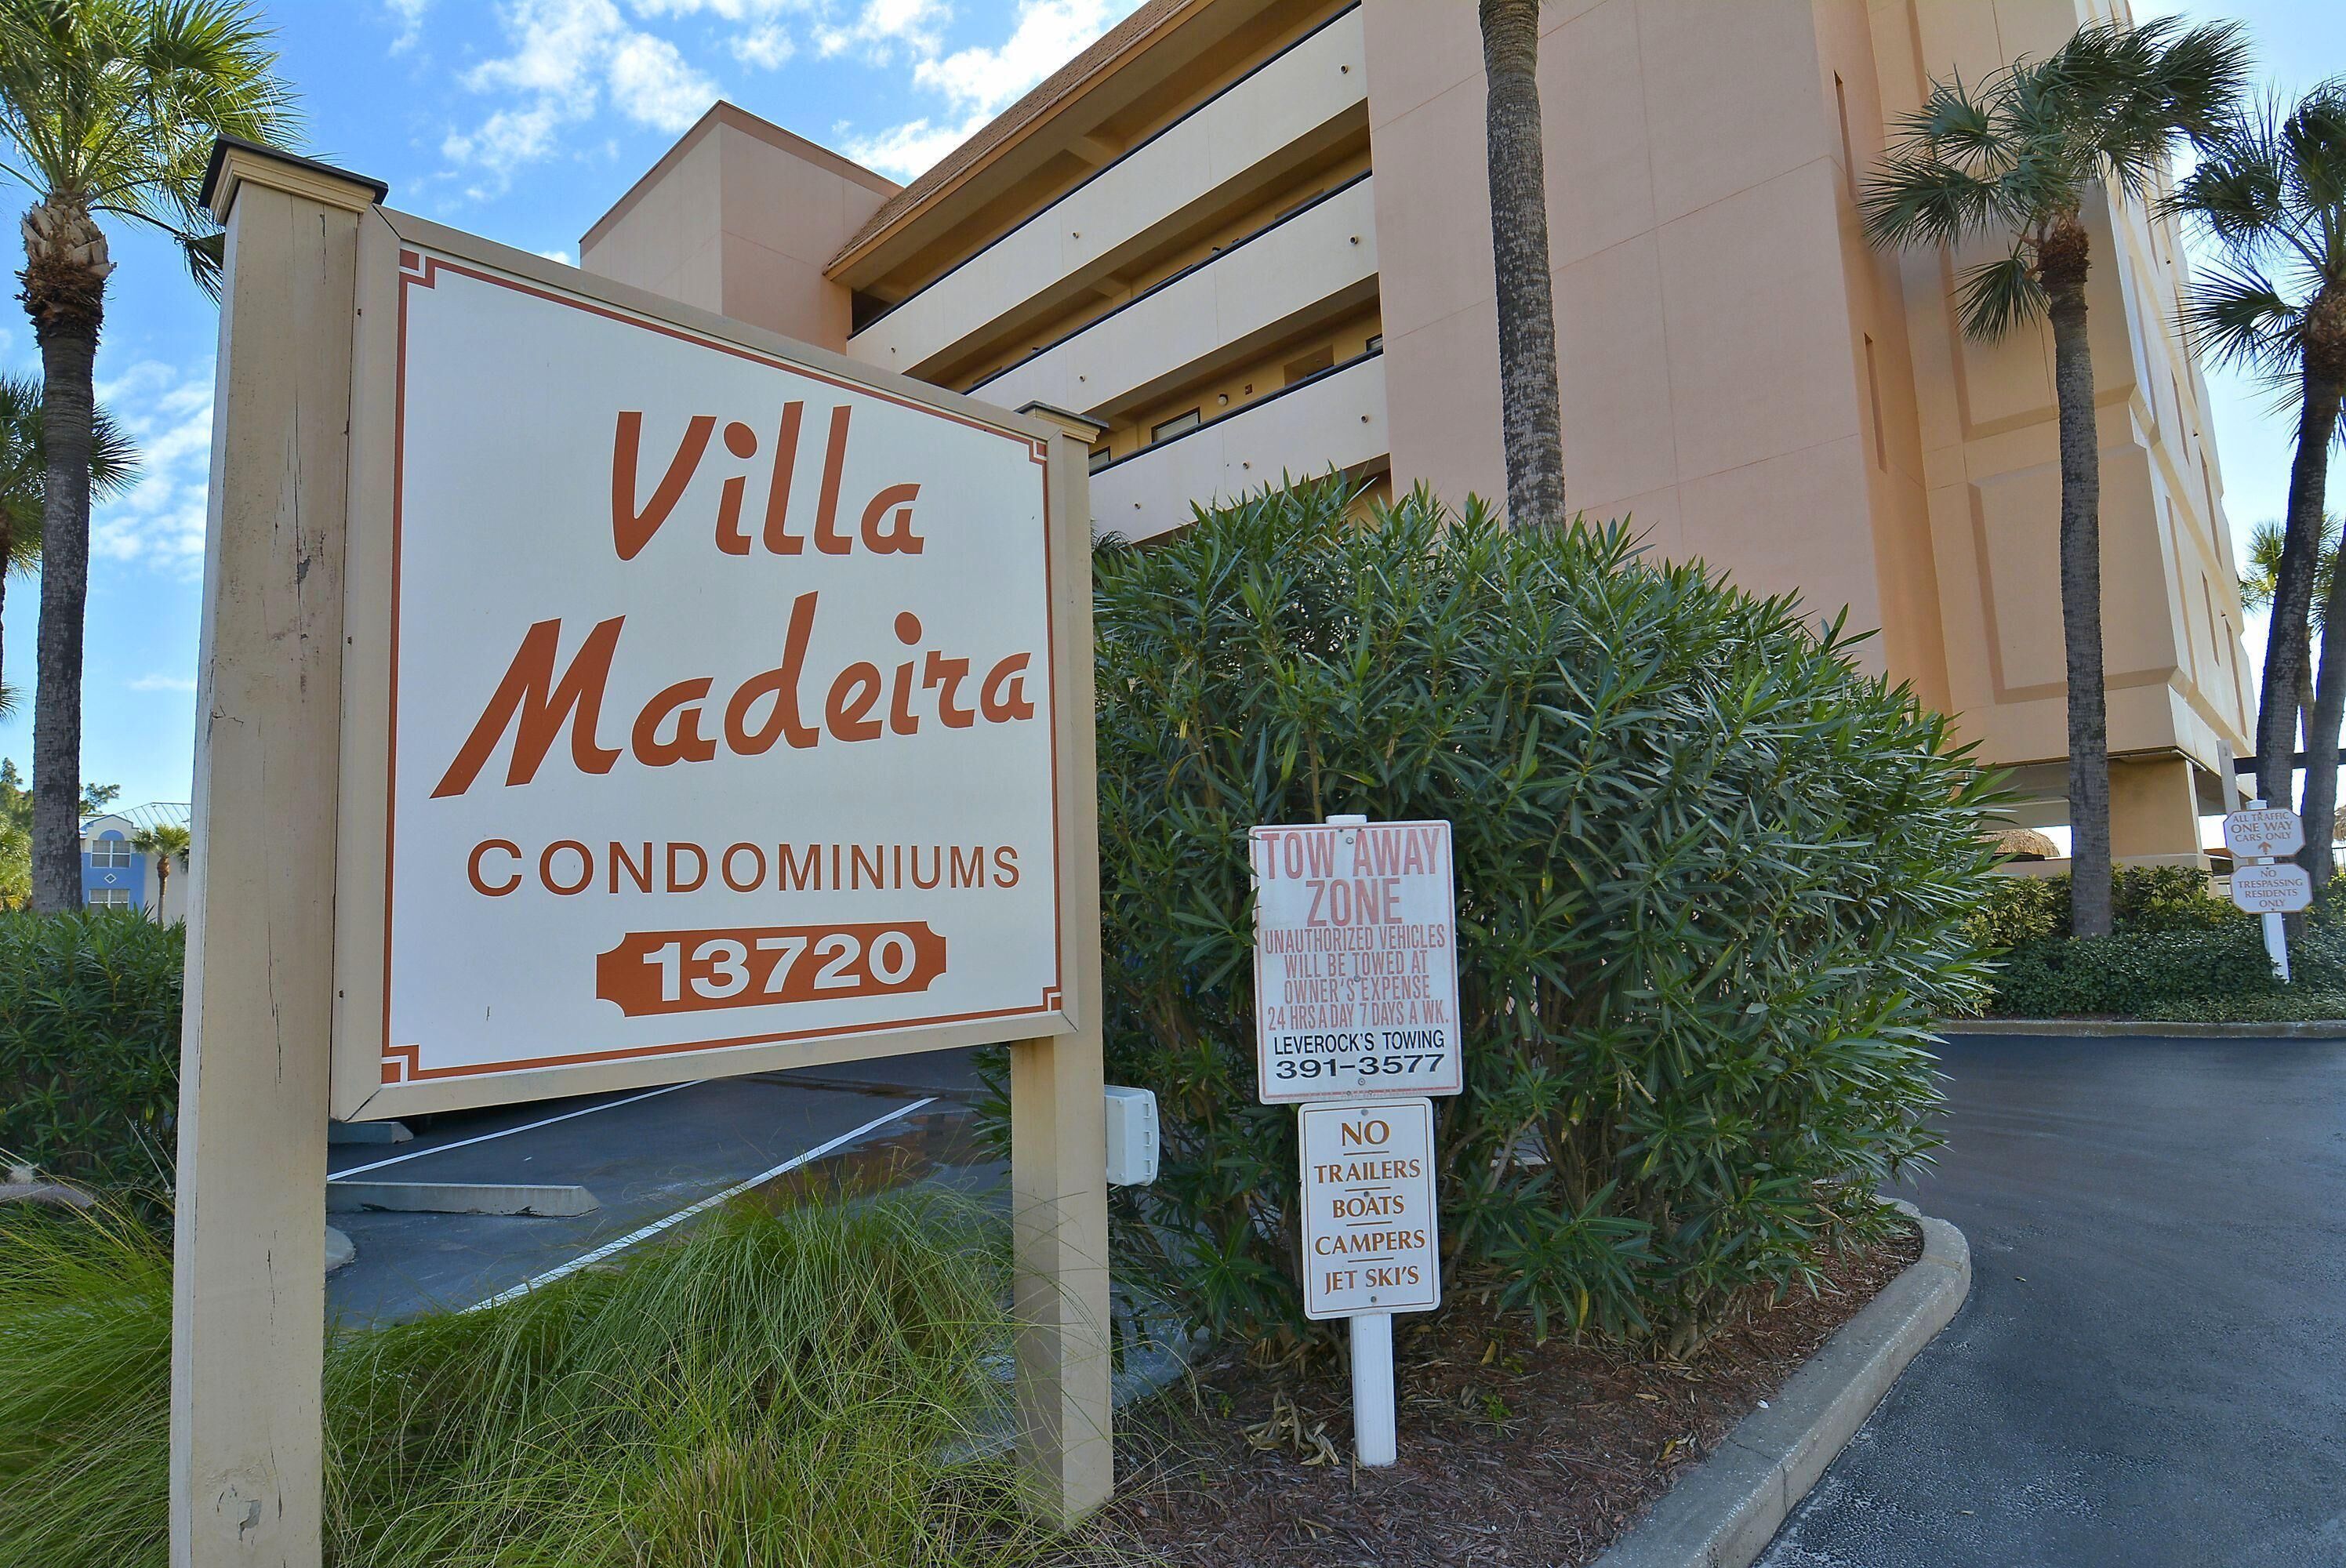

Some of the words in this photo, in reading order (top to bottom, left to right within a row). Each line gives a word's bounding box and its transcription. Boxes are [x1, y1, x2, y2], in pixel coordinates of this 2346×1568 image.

[611, 401, 925, 561] Villa
[428, 590, 1035, 800] Madeira
[2231, 823, 2259, 833] ONE
[2264, 821, 2293, 831] WAY
[2252, 812, 2290, 821] TRAFFIC
[2235, 833, 2261, 842] CARS
[2266, 832, 2291, 840] ONLY
[1261, 831, 1334, 880] TOW
[1353, 828, 1440, 877] AWAY
[467, 838, 1020, 898] CONDOMINIUMS
[2238, 878, 2303, 888] TRESPASSING
[2245, 888, 2298, 898] RESIDENTS
[1306, 878, 1403, 927] ZONE
[2259, 899, 2286, 908] ONLY
[1265, 927, 1373, 954] UNAUTHORIZED
[1379, 924, 1445, 950] VEHICLES
[642, 931, 917, 1003] 13720
[1284, 953, 1321, 978] WILL
[1327, 953, 1346, 977] BE
[1353, 951, 1405, 977] TOWED
[1411, 950, 1428, 974] AT
[1284, 978, 1355, 1004] OWNER'S
[1361, 975, 1431, 1002] EXPENSE
[1268, 1007, 1286, 1031] 24
[1291, 1004, 1316, 1029] HRS
[1319, 1004, 1327, 1028] A
[1331, 1003, 1355, 1027] DAY
[1361, 1003, 1367, 1026] 7
[1372, 1001, 1404, 1026] DAYS
[1411, 1000, 1418, 1024] A
[1422, 1000, 1449, 1025] WK.
[1274, 1033, 1375, 1054] LEVEROCK'S
[1382, 1029, 1445, 1051] TOWING
[1276, 1054, 1445, 1080] 391-3577
[1342, 1120, 1390, 1146] NO
[1313, 1159, 1422, 1184] TRAILERS
[1332, 1195, 1405, 1218] BOATS
[1315, 1229, 1425, 1255] CAMPERS
[1325, 1270, 1357, 1295] JET
[1365, 1265, 1420, 1289] SKI'S
